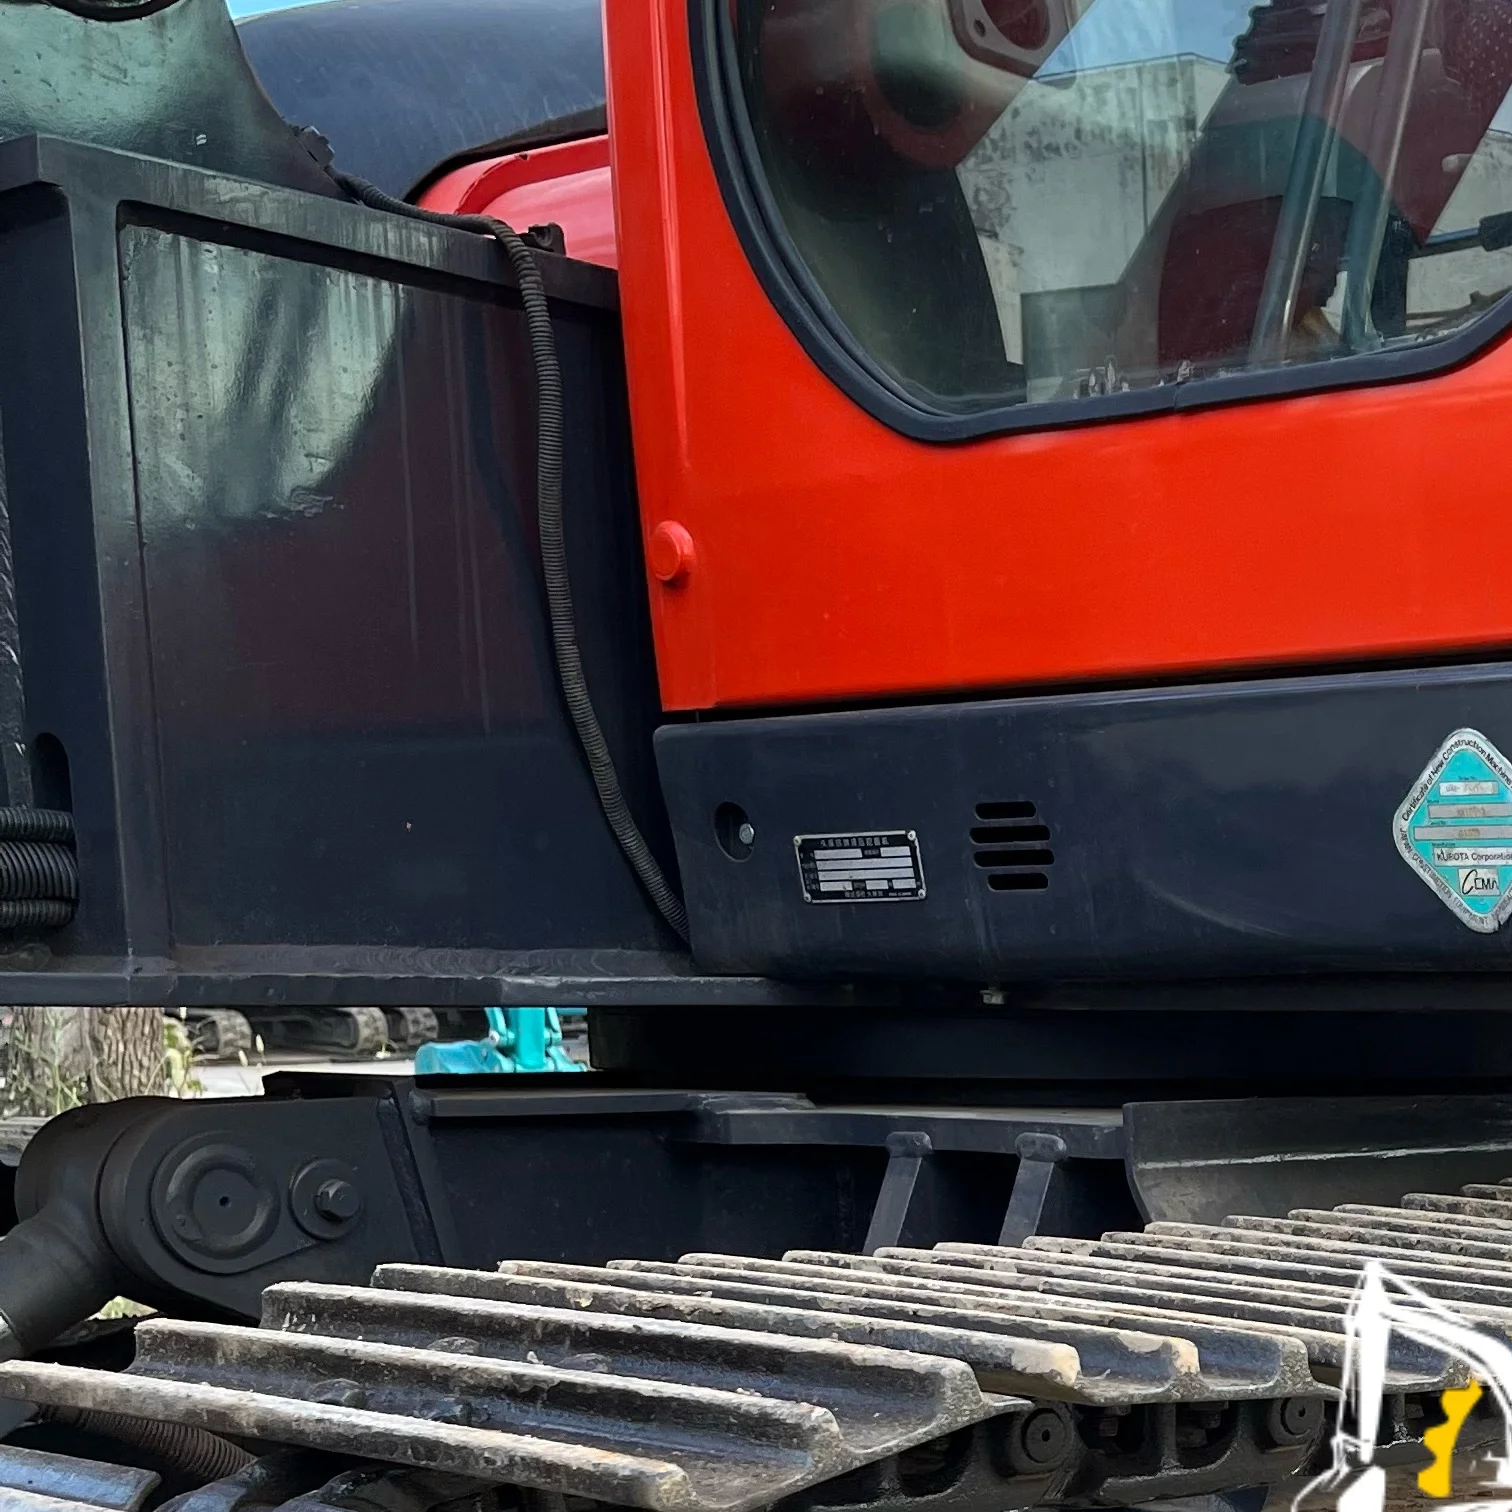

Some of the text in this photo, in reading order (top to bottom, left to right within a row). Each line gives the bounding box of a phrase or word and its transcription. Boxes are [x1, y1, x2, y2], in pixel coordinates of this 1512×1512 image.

[1402, 784, 1428, 821] Certificate
[1427, 774, 1434, 786] of
[1431, 760, 1444, 777] New
[1443, 740, 1487, 760] Construction
[1437, 850, 1469, 861] KUBOTA
